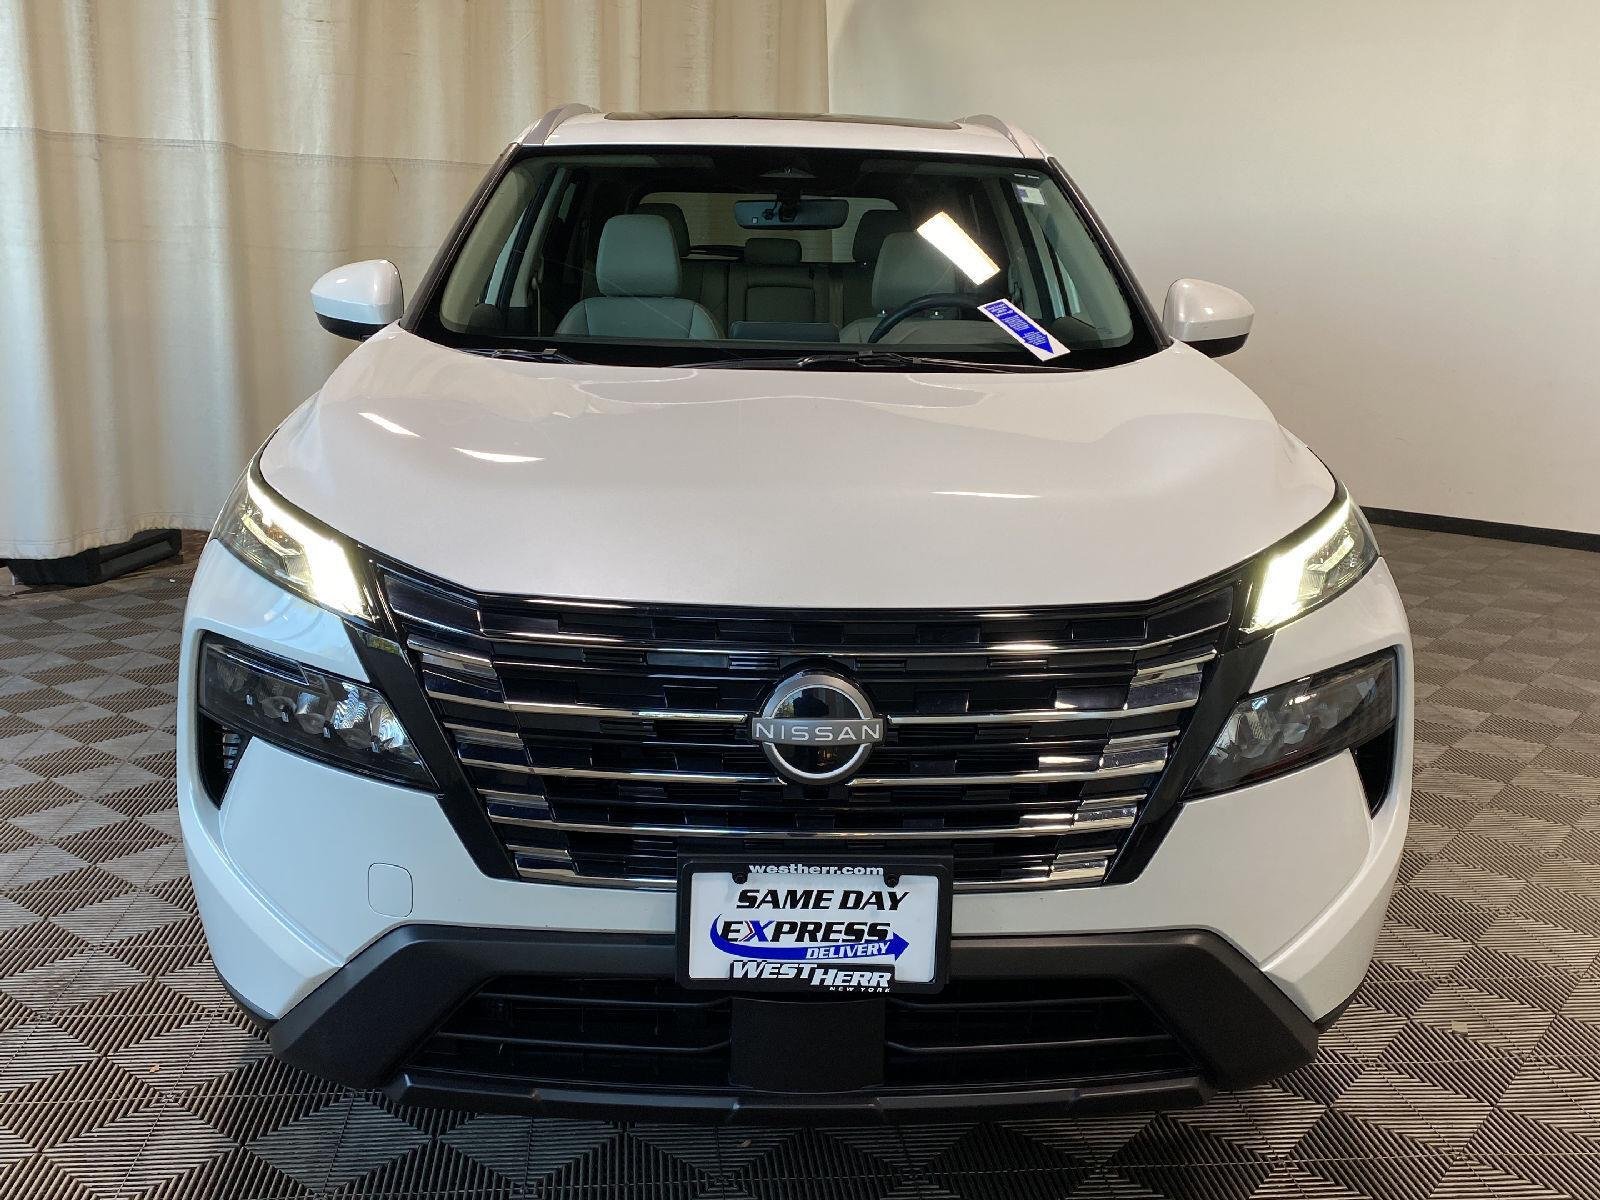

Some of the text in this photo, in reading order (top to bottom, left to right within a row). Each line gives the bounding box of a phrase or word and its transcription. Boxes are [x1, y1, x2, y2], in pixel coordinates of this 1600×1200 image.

[755, 722, 880, 741] NISSAN
[749, 863, 884, 876] westherr.com
[736, 889, 910, 911] SAME DAY
[720, 920, 890, 943] EXPRESS
[806, 942, 890, 960] DELIVERY
